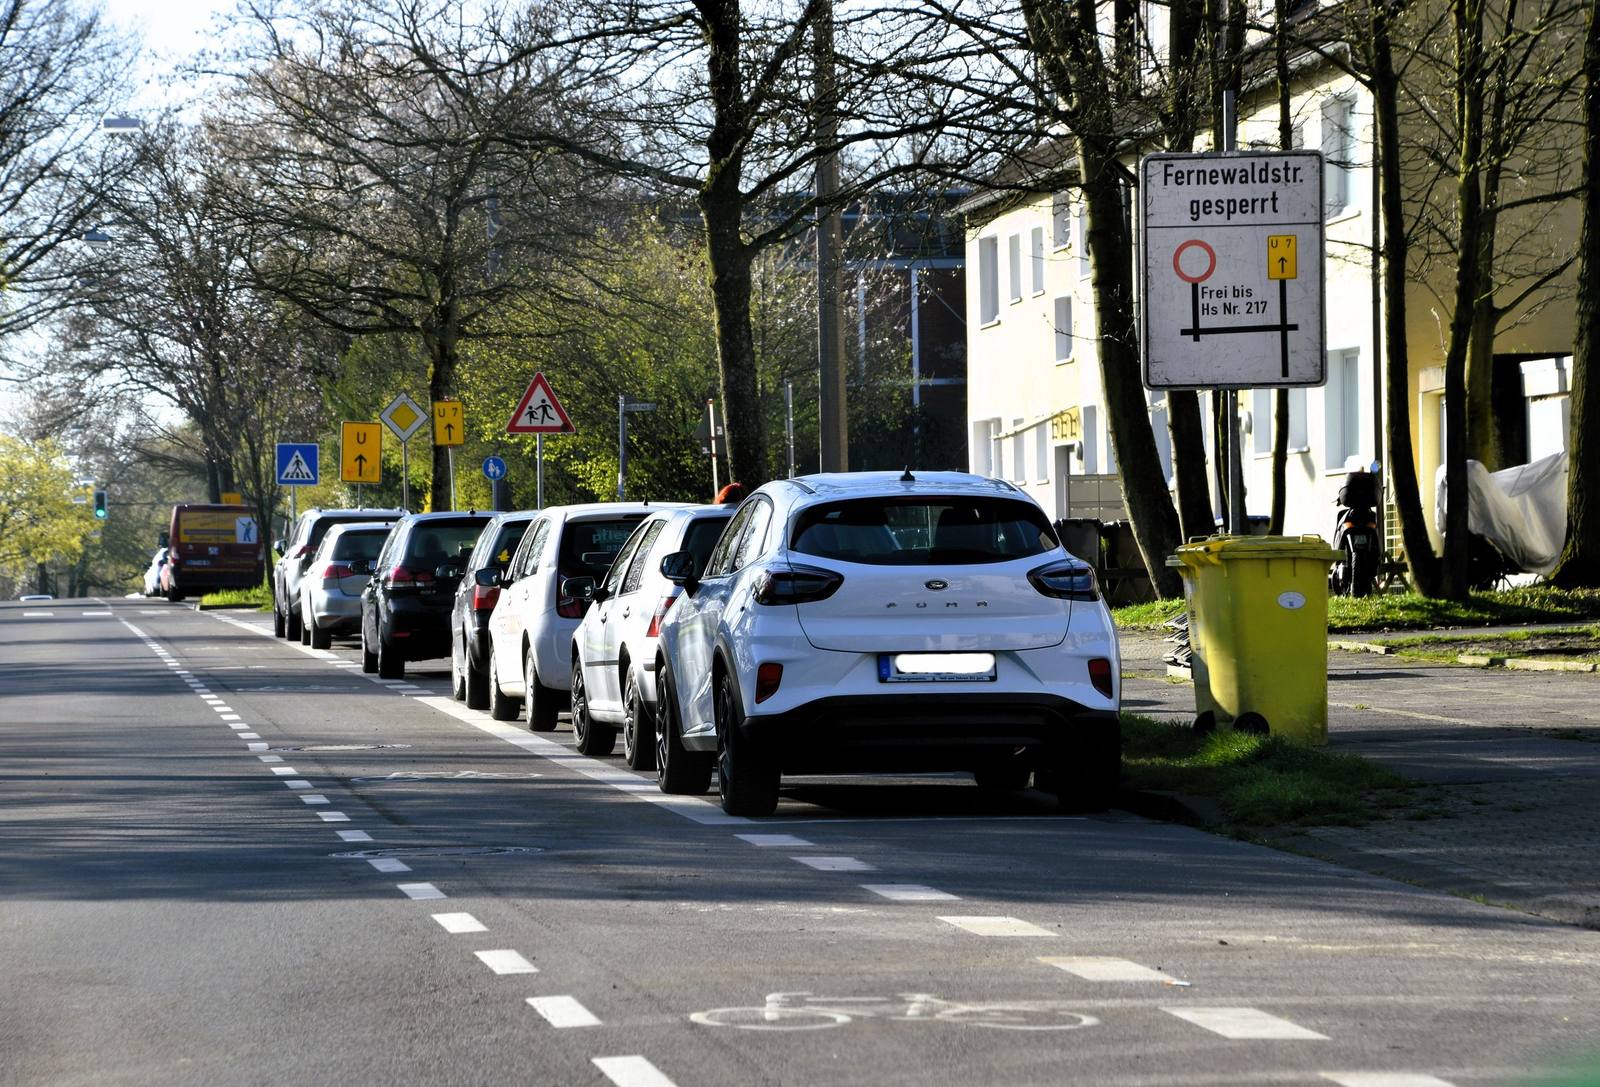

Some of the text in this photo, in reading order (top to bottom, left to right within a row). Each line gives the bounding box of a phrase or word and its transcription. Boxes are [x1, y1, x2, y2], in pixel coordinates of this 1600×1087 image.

[1163, 161, 1304, 186] Fernewaldstr.
[1189, 191, 1279, 221] gesperrt
[1270, 238, 1292, 249] U 7
[1201, 285, 1253, 299] Frei bis
[1201, 301, 1268, 316] Hs Nr. 217
[438, 407, 458, 418] U 7
[356, 432, 367, 445] U
